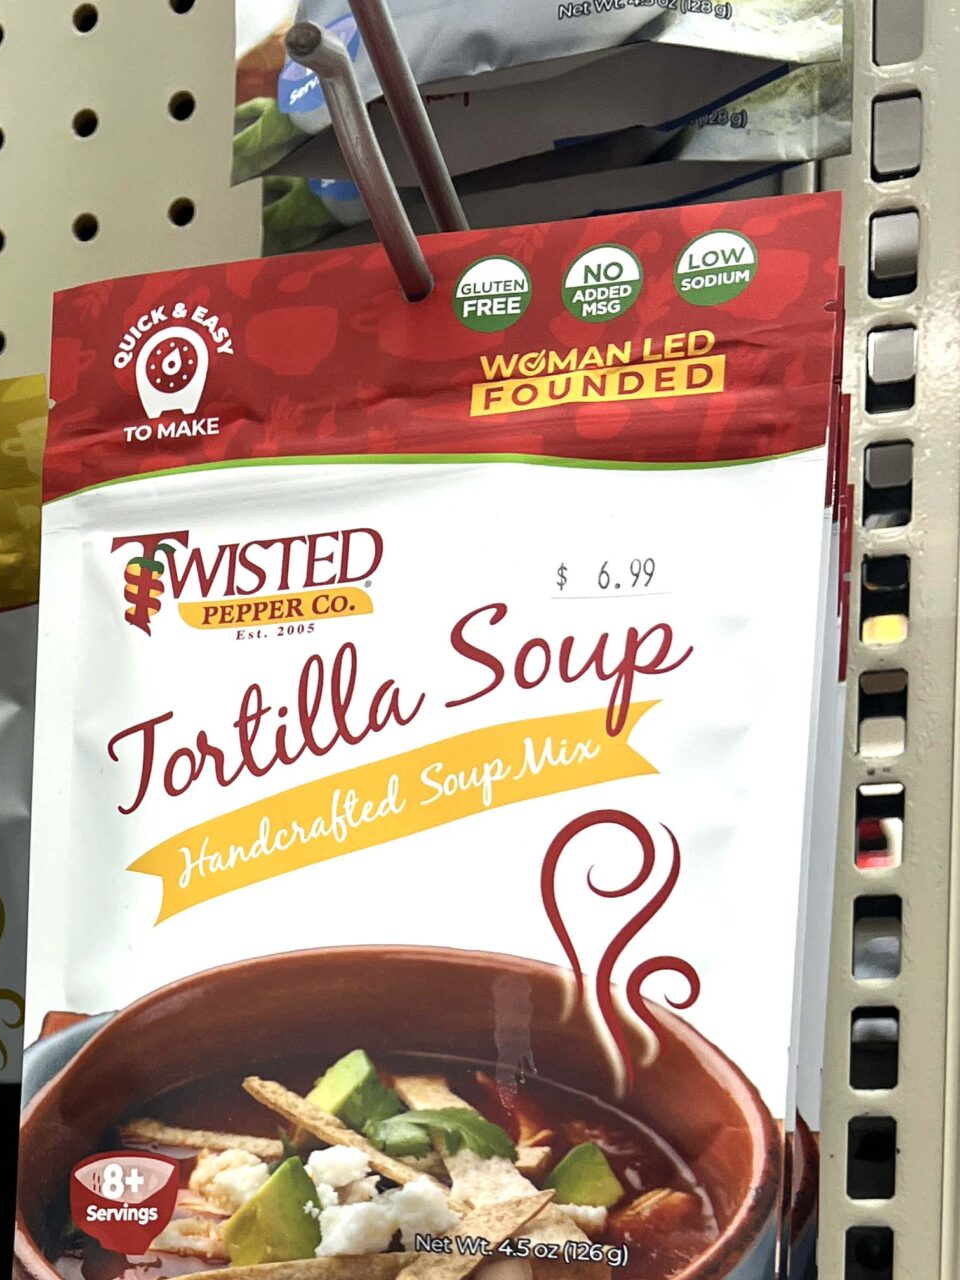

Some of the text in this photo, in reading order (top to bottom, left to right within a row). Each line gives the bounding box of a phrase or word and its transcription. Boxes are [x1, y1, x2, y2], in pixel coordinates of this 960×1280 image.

[558, 2, 589, 19] Net
[714, 3, 732, 19] g)
[688, 247, 745, 270] LOW
[584, 262, 623, 284] NO
[680, 270, 750, 291] SODIUM
[461, 279, 525, 296] GLUTEN
[572, 285, 632, 303] ADDED
[463, 297, 521, 317] FREE
[582, 300, 621, 316] MSG
[114, 303, 234, 369] QUICK & EASY
[480, 329, 716, 380] WOMAN LED
[483, 363, 713, 410] FOUNDED
[124, 417, 219, 442] TO MAKE
[111, 527, 384, 637] TWISTED
[555, 558, 656, 590] $ 6.99
[202, 598, 304, 626] PEPPER
[235, 623, 315, 640] Est. 2005
[108, 602, 694, 815] Tortilla Soup
[178, 735, 601, 889] Handcrafted Soup Mix
[102, 1164, 144, 1200] 8+
[86, 1202, 158, 1225] Servings
[415, 1235, 628, 1267] Net Wt. 4.5 oz (126 g)
